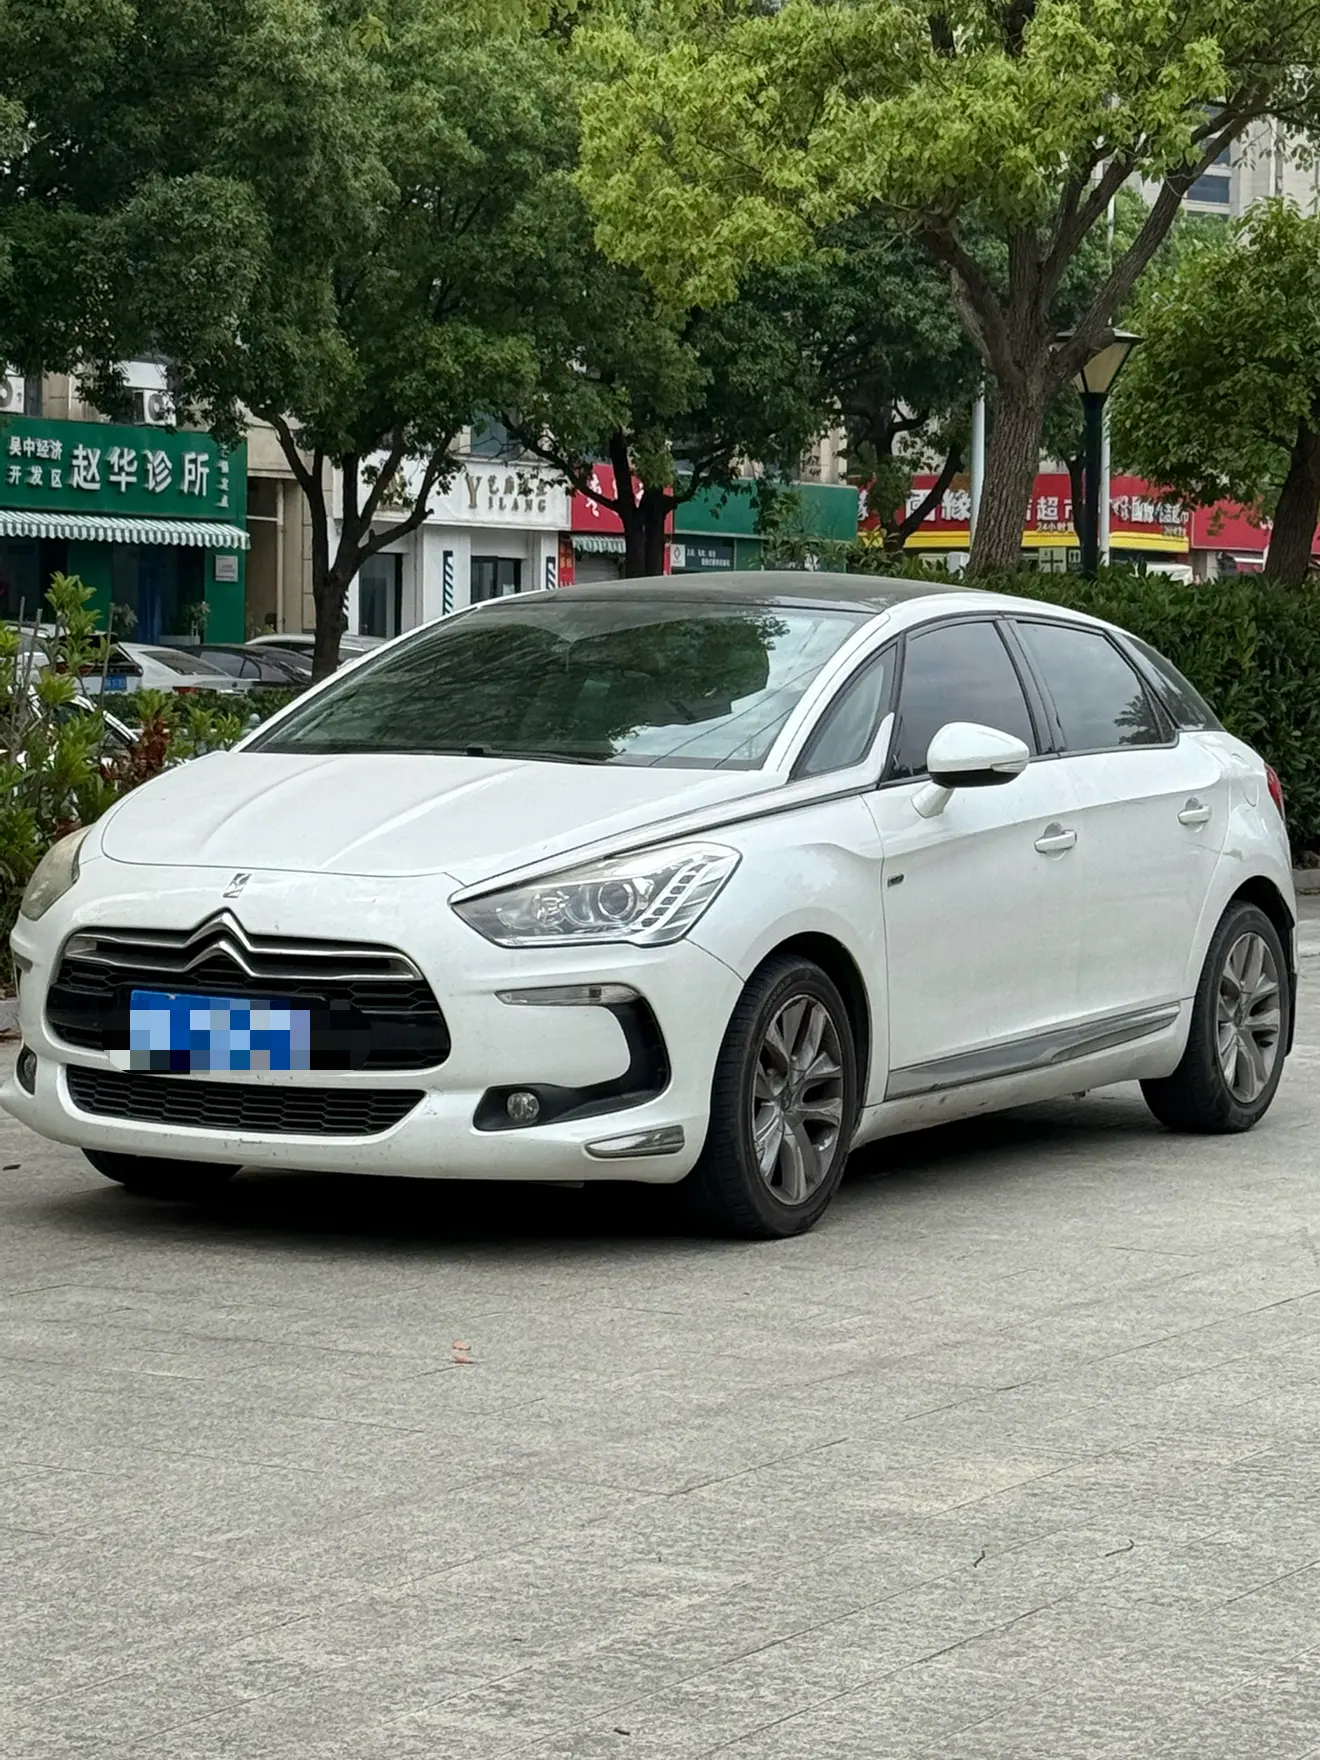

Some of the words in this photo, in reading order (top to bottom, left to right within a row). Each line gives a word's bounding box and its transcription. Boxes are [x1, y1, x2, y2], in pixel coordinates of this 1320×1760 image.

[8, 436, 63, 460] 吴中经济
[8, 465, 62, 488] 开发区
[71, 444, 210, 496] 赵华诊所
